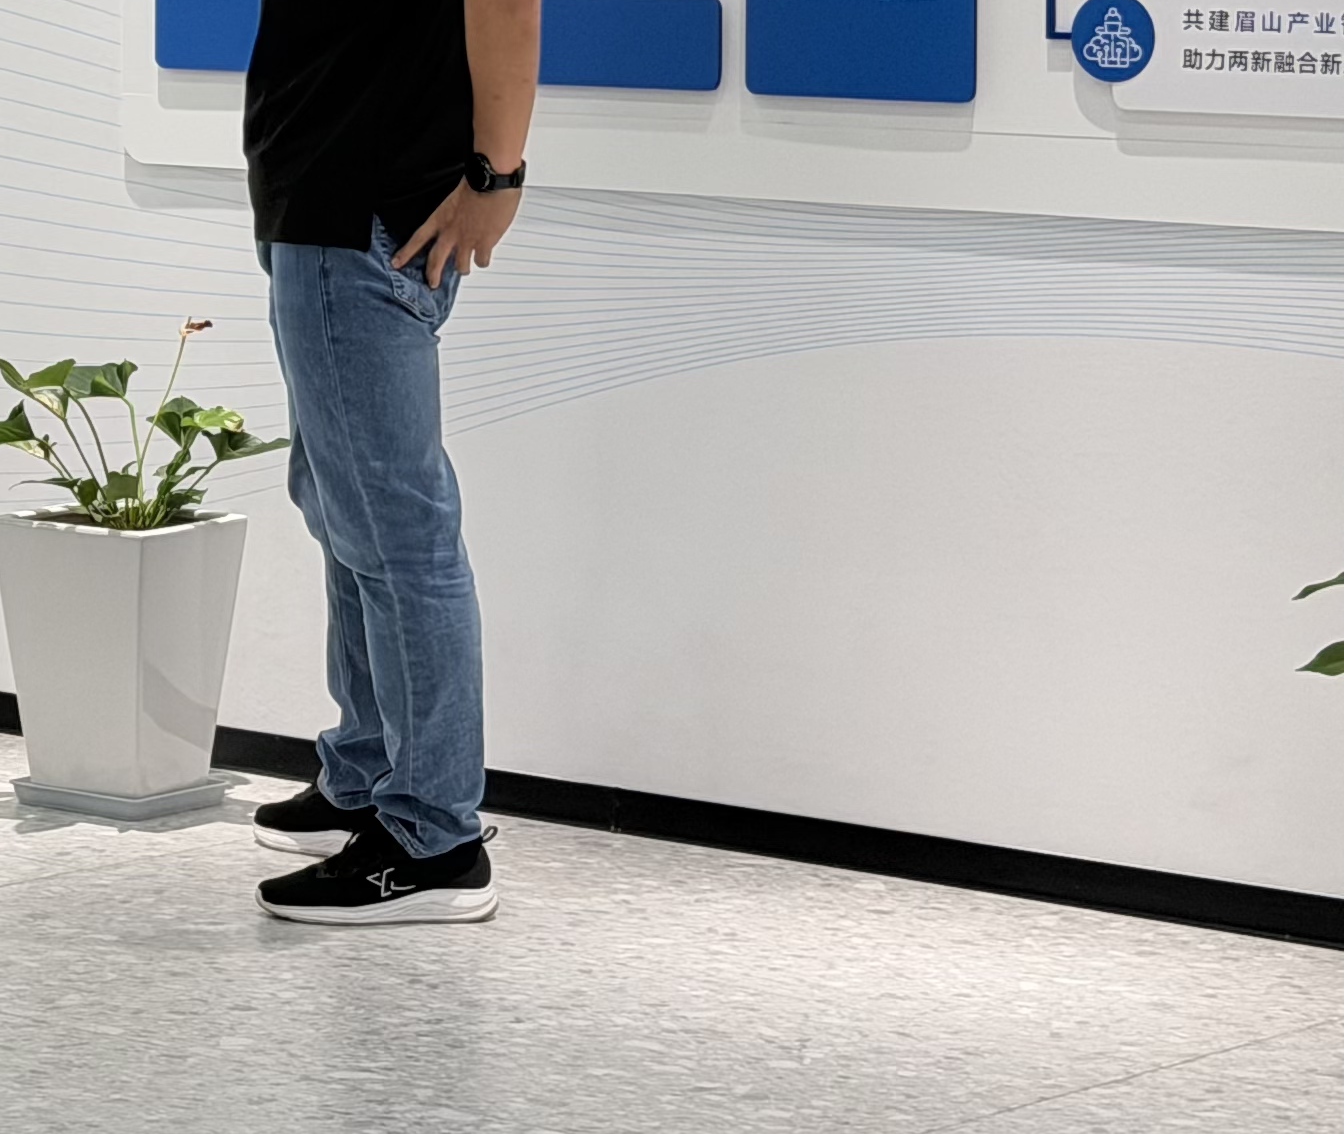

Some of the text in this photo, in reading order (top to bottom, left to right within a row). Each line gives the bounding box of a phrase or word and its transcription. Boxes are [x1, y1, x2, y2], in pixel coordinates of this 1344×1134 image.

[1182, 8, 1344, 35] 共建眉山产业
[1182, 48, 1342, 76] 助力两新融合新
